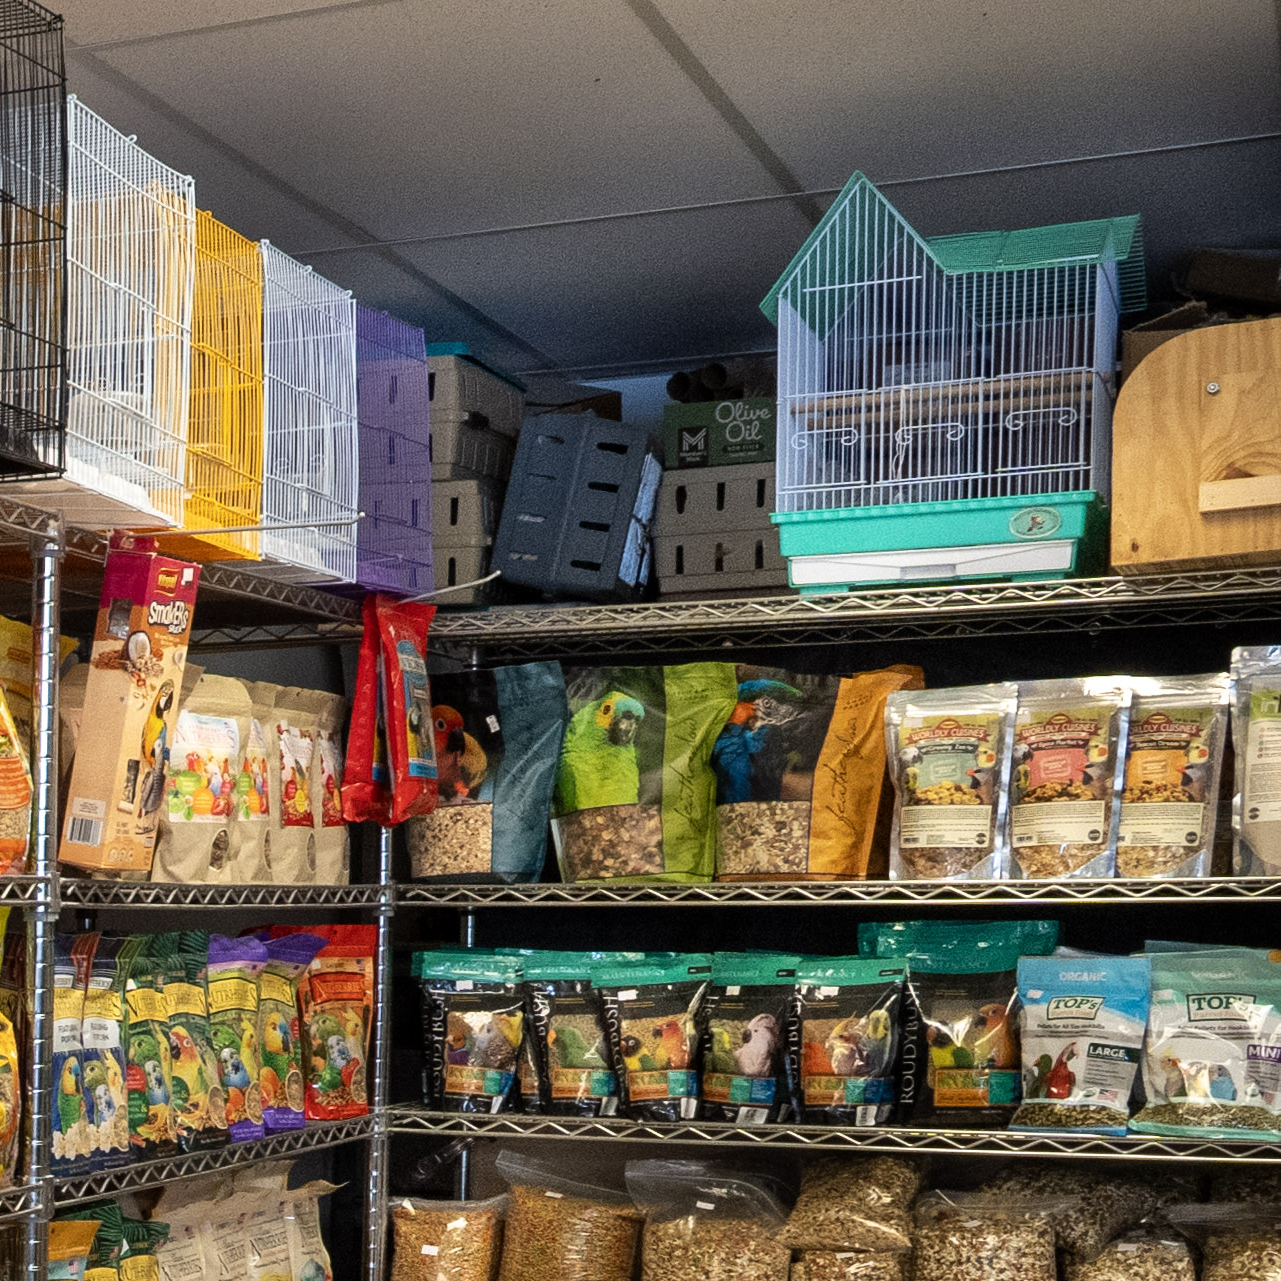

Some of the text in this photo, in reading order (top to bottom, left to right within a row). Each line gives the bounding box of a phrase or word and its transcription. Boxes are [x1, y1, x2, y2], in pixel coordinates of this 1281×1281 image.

[715, 401, 772, 423] Olive
[725, 420, 763, 442] Oil
[911, 727, 985, 740] WORLDLY CUISINES
[1022, 723, 1096, 737] WORLDLY CUISINES
[1167, 723, 1204, 735] CUISINES
[1058, 971, 1107, 982] ORGANIC
[1052, 997, 1098, 1011] TOP's
[1088, 1045, 1127, 1059] LARGE
[1248, 1045, 1280, 1059] MINI
